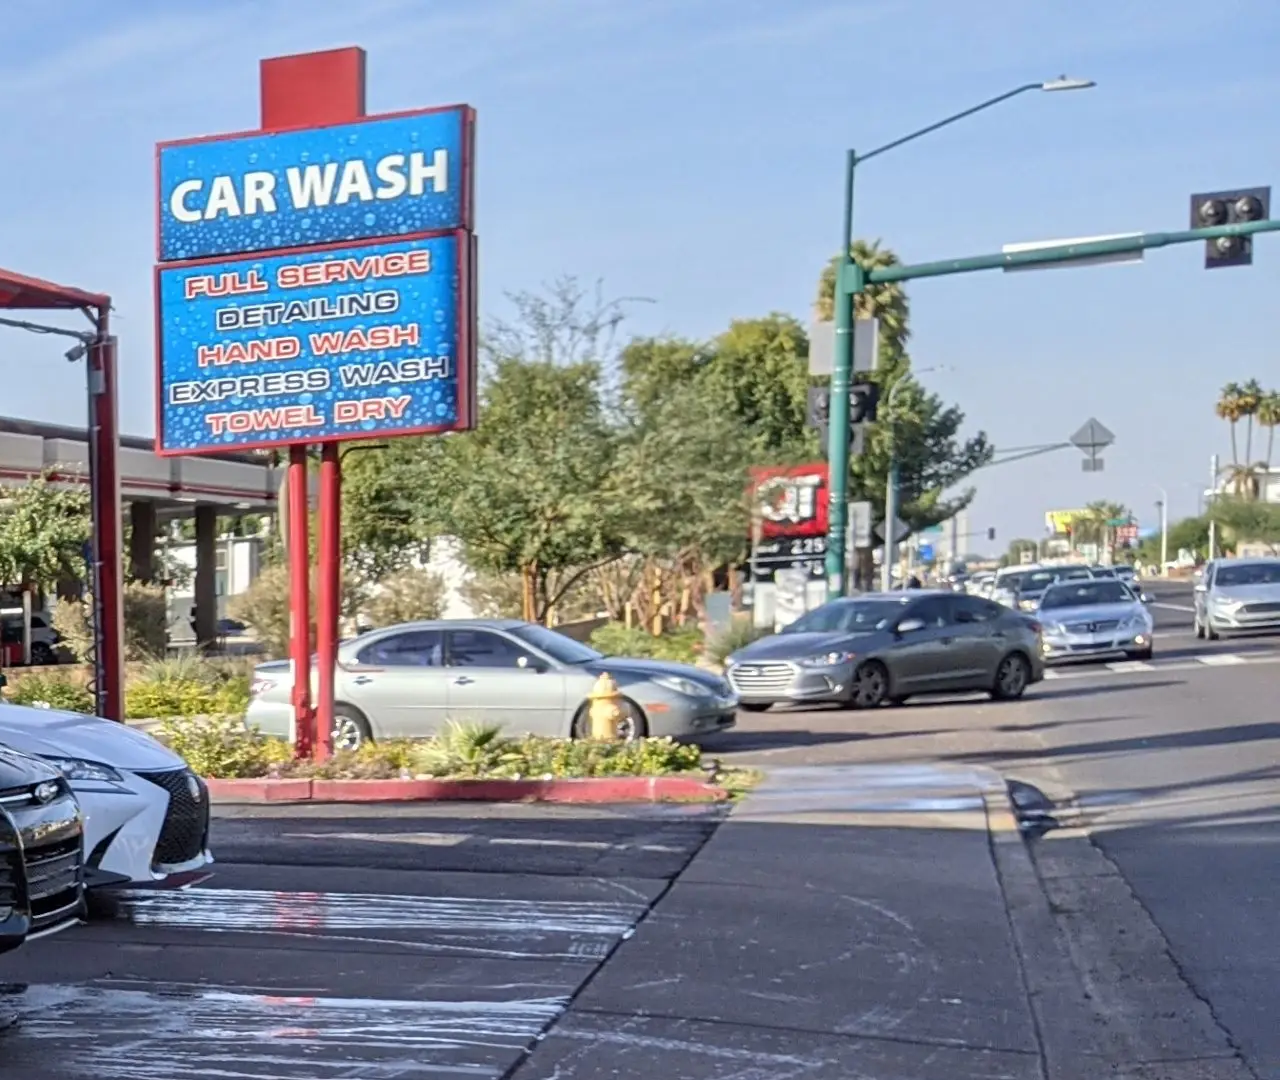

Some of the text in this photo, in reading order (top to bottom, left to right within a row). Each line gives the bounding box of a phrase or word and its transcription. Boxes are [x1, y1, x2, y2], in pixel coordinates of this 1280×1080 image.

[170, 148, 449, 223] CAR WASH
[185, 249, 430, 299] FULL SERVICE
[216, 291, 399, 330] DETAILING
[197, 324, 419, 367] HAND WASH
[170, 357, 450, 404] EXPRESS WASH
[205, 396, 412, 435] TOWEL DRY
[757, 473, 822, 522] QT
